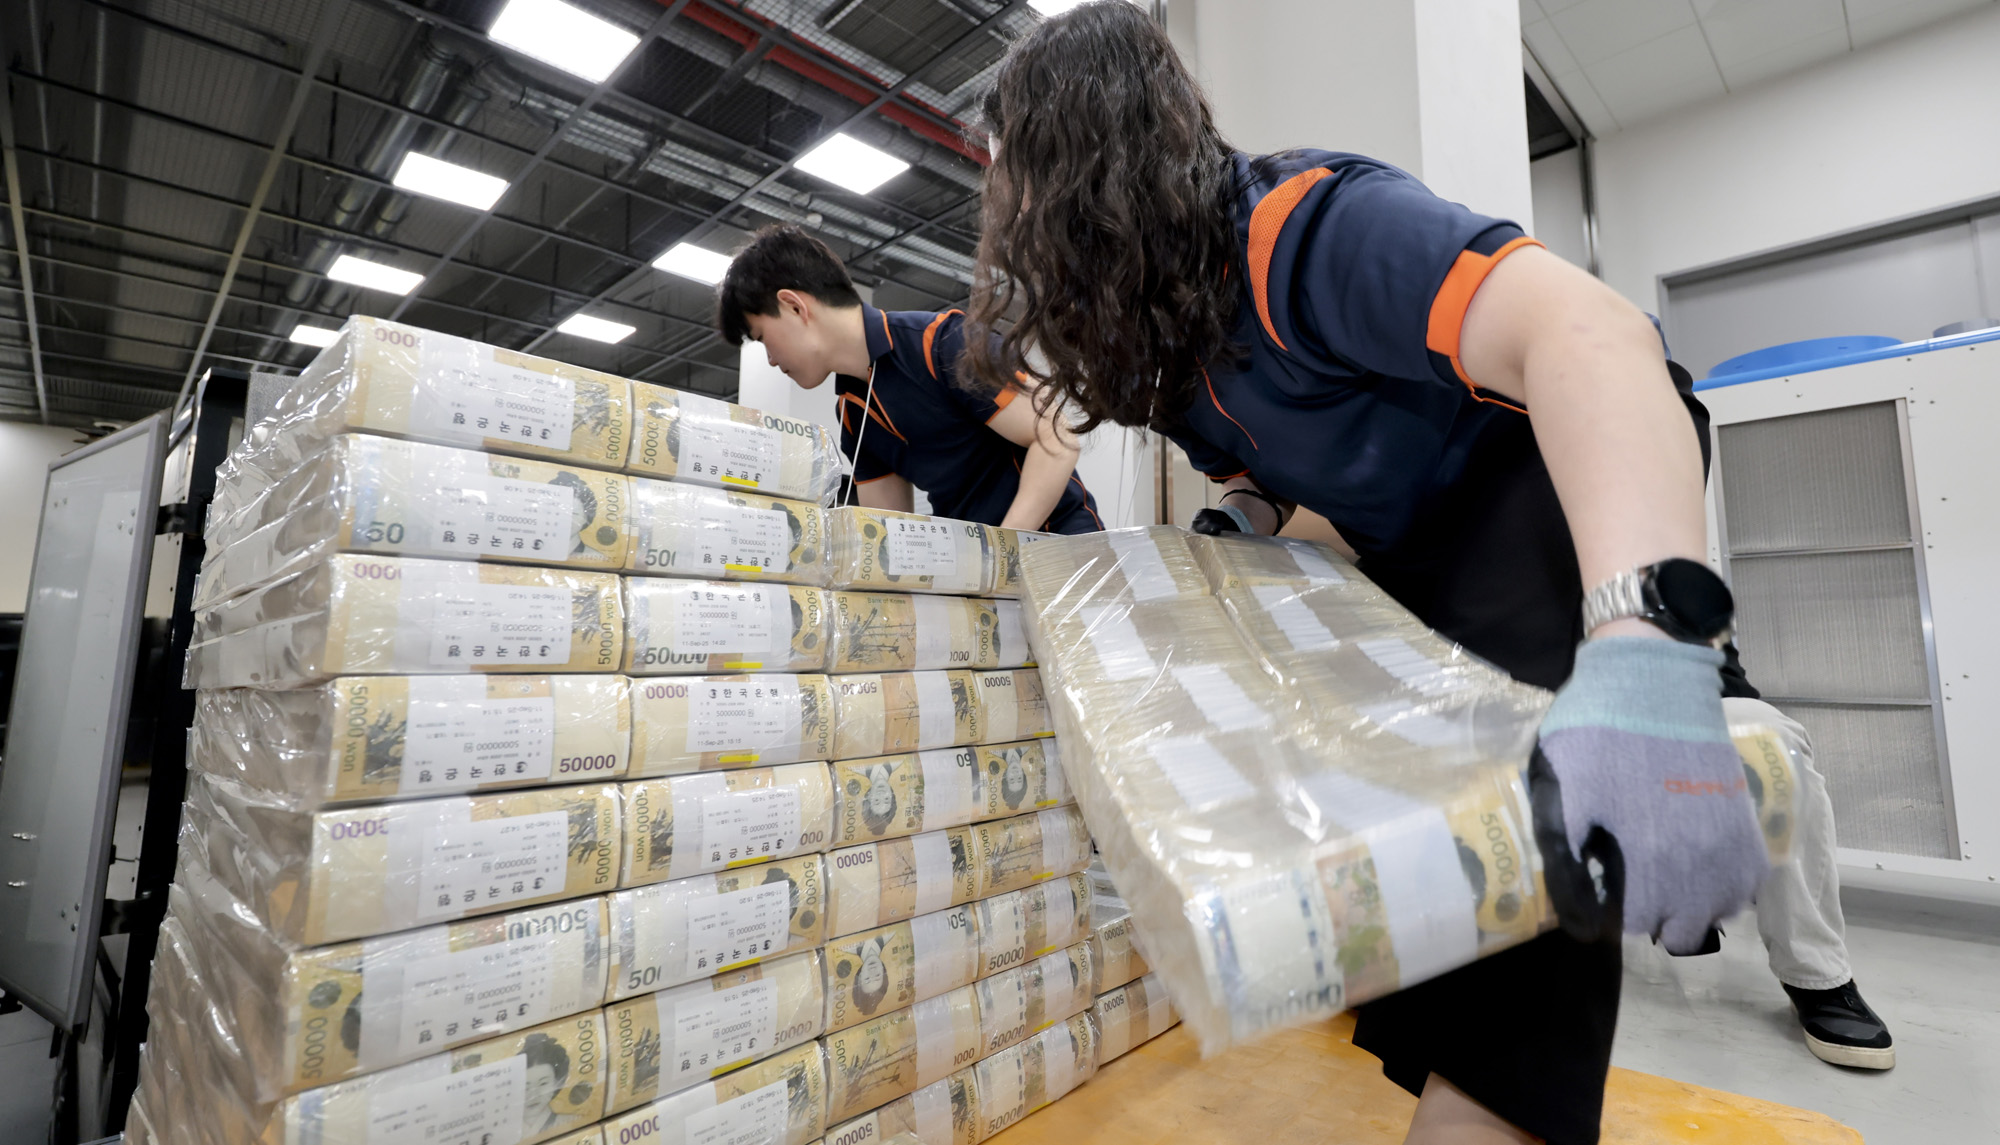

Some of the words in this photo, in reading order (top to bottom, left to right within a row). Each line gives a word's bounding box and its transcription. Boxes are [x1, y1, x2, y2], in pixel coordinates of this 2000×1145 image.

[374, 327, 422, 349] 000
[606, 418, 622, 461] 50000
[764, 415, 813, 439] 50000
[643, 421, 660, 467] 50000
[604, 477, 619, 522] 50000
[805, 506, 818, 545] 50000
[964, 526, 982, 539] 50
[353, 563, 402, 581] 000
[645, 549, 676, 567] 50
[861, 542, 873, 581] 50000
[805, 589, 819, 628] 50000
[598, 622, 614, 665] 50000
[979, 630, 989, 664] 50000
[723, 688, 779, 699] 한국은행
[984, 677, 1011, 688] 50000
[351, 686, 368, 738] 50000
[343, 742, 356, 772] won
[559, 754, 616, 773] 50000
[636, 788, 649, 834] 50000
[988, 779, 996, 814] 50000
[602, 809, 611, 837] won
[844, 800, 856, 841] 50000
[595, 837, 610, 884] 50000
[635, 836, 646, 862] won
[712, 841, 770, 862] 한국은행
[837, 850, 873, 869] 50000
[1481, 811, 1516, 886] 50000
[437, 881, 525, 907] 한국은행
[803, 861, 817, 905] 50000
[1104, 925, 1124, 941] 50000
[697, 943, 757, 970] 한국은행
[988, 947, 1025, 971] 50000
[628, 966, 661, 990] 50
[834, 983, 846, 1026] 50000
[1104, 993, 1124, 1013] 50000
[302, 1017, 328, 1079] 50000
[577, 1019, 594, 1075] 50000
[618, 1009, 634, 1059] 50000
[990, 1024, 1025, 1050] 50000
[680, 1042, 742, 1072] 한국은행
[619, 1060, 629, 1089] won
[987, 1106, 1024, 1136] 50000
